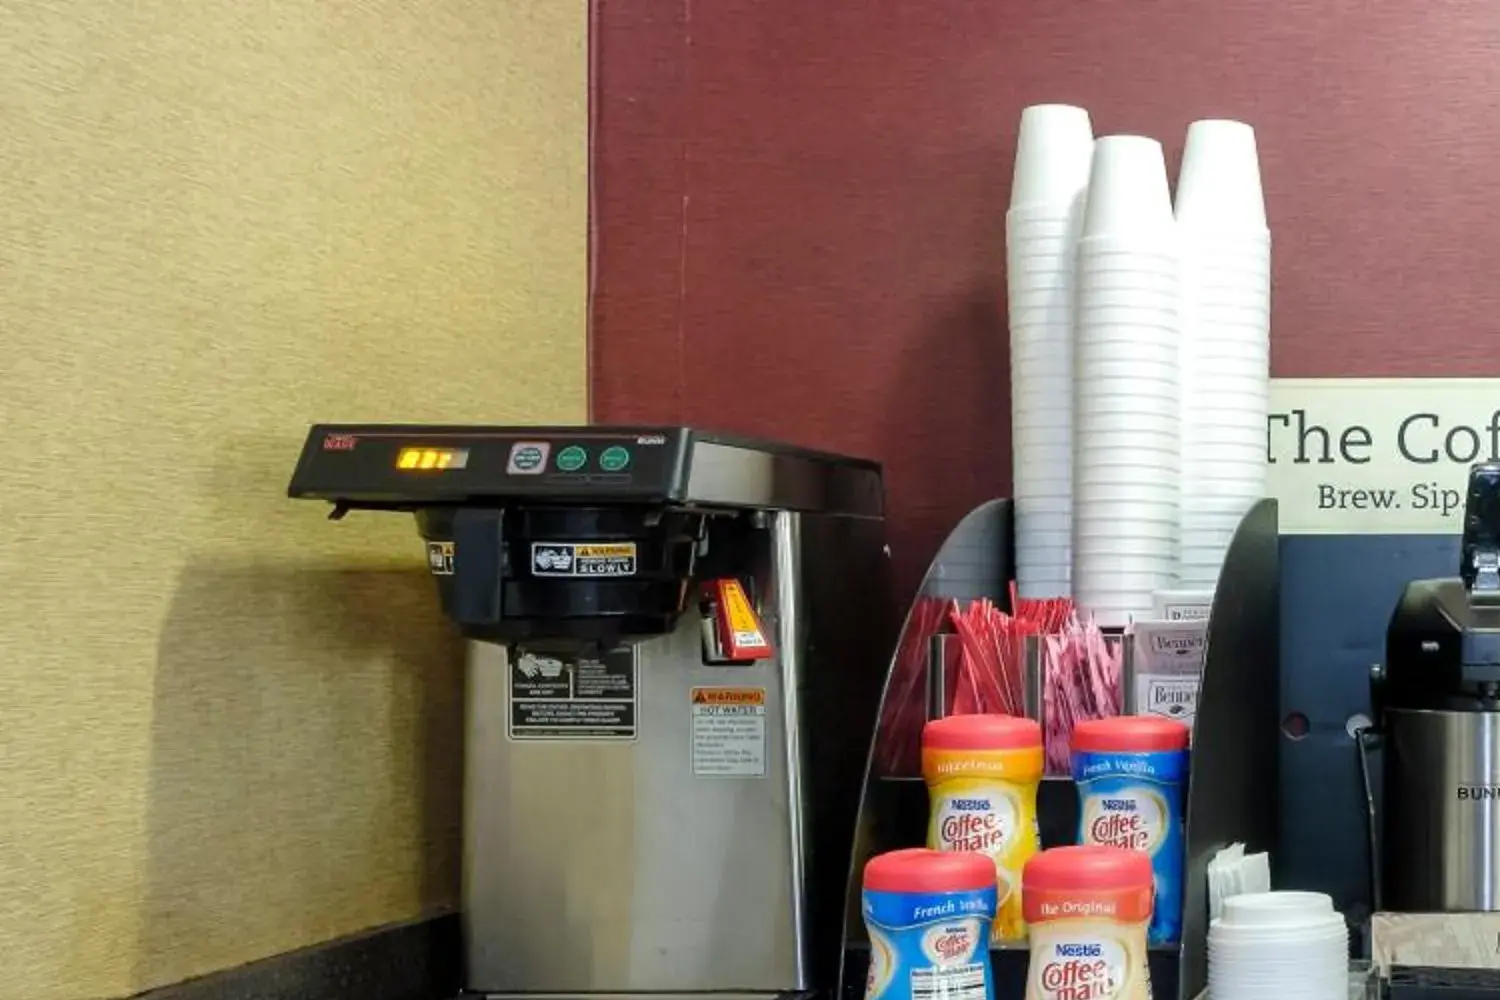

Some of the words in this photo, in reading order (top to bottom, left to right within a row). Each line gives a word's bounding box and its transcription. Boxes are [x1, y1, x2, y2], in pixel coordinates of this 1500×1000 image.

[1317, 483, 1401, 509] Brew.
[1411, 482, 1467, 517] Sip.
[914, 900, 956, 920] French
